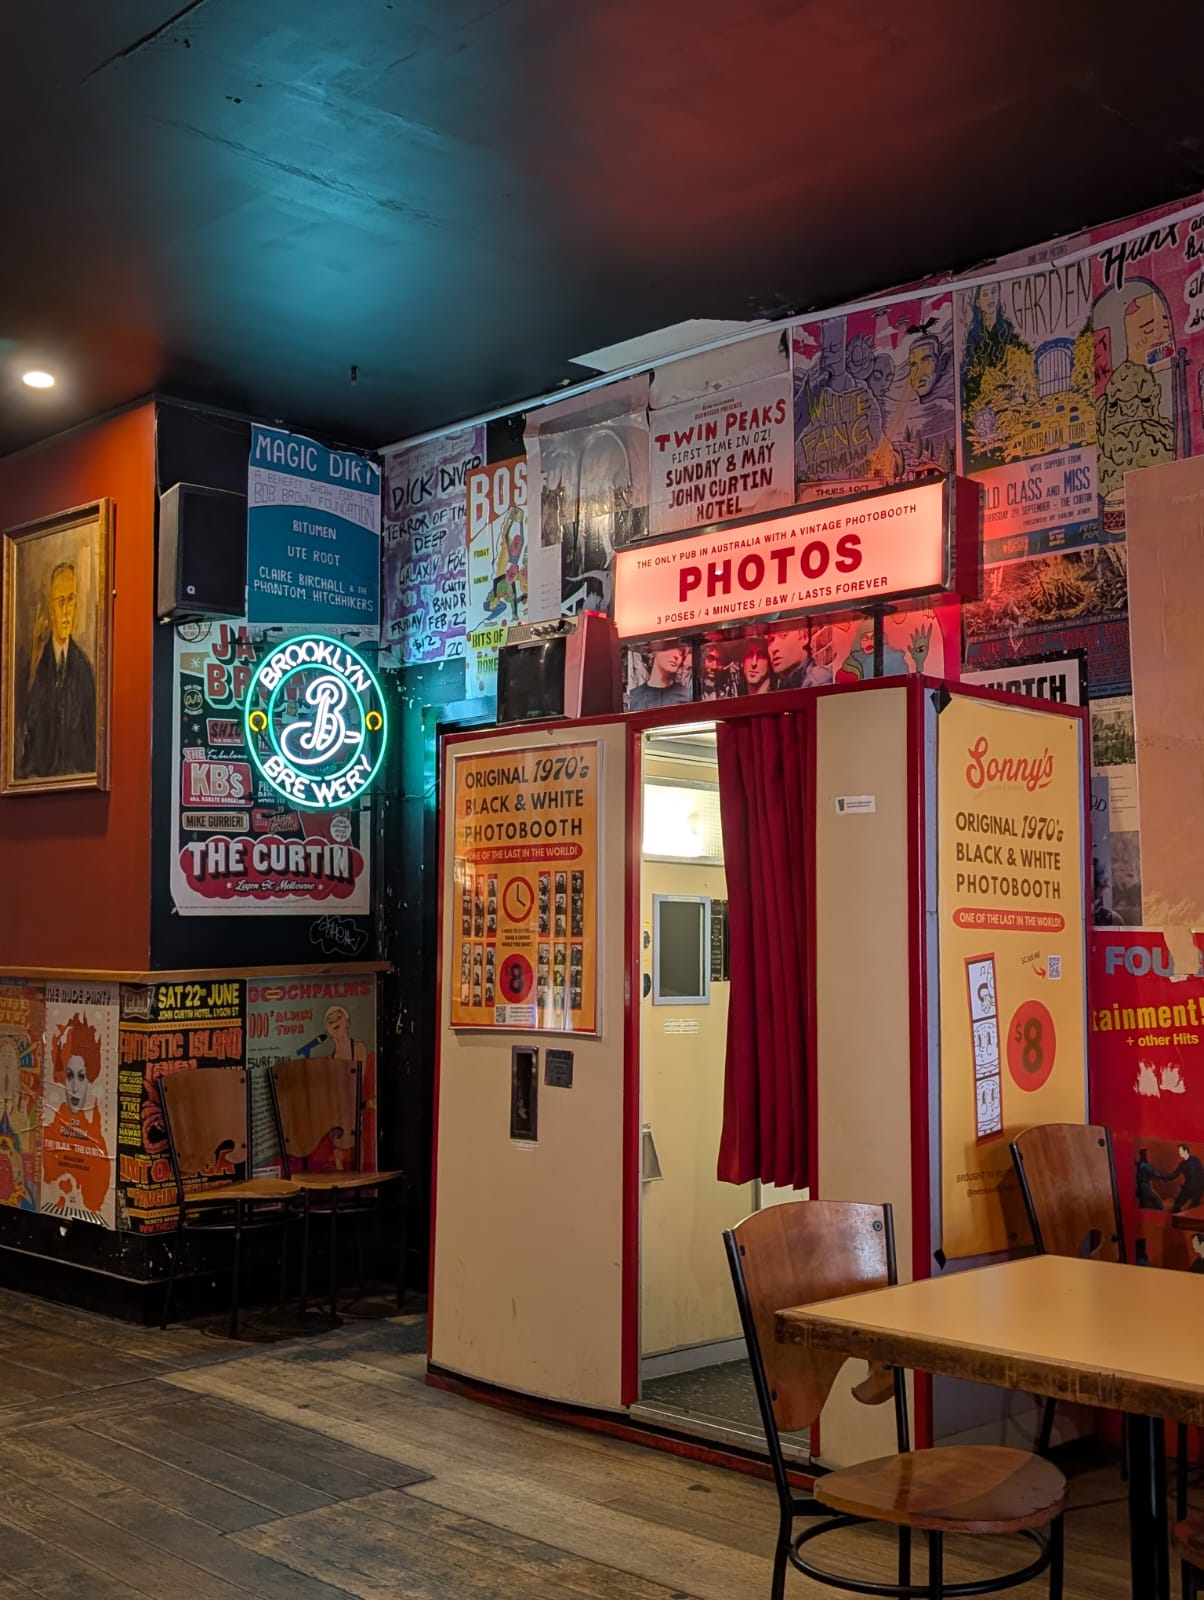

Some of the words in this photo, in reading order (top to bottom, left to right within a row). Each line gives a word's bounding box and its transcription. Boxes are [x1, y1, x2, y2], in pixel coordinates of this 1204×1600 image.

[1100, 224, 1178, 290] Hunx
[1012, 257, 1092, 335] GARDEN
[809, 390, 869, 425] WHITE
[655, 420, 719, 453] TWIN
[725, 398, 787, 441] PEAKS
[801, 415, 873, 460] FANG
[1022, 428, 1064, 451] AUSTRALIAN
[1068, 423, 1086, 442] TOUR
[255, 434, 318, 473] MAGIC
[330, 455, 375, 486] DIRT
[672, 446, 703, 465] FIRST
[705, 439, 733, 457] TIME
[736, 434, 750, 448] IN
[753, 429, 772, 445] OZ!
[806, 446, 868, 477] AUSTRALIAN
[665, 458, 720, 488] SUNDAY
[725, 456, 736, 472] 8
[741, 442, 776, 470] MAY
[1030, 462, 1043, 473] WITH
[1043, 457, 1066, 471] SUPPORT
[1068, 454, 1082, 466] FROM
[392, 474, 433, 511] DICK
[668, 485, 706, 509] JOHN
[709, 467, 773, 500] CURTIN
[816, 486, 845, 497] THURS
[853, 485, 869, 493] OCT
[1006, 476, 1042, 507] CLASS
[1046, 484, 1060, 497] AND
[1064, 466, 1091, 495] MISS
[319, 497, 376, 530] FOUNDATION
[696, 497, 743, 523] HOTEL
[1021, 501, 1051, 516] SEPTEMBER
[1061, 497, 1072, 508] THE
[1073, 492, 1092, 506] CURTIN
[292, 520, 337, 540] BITUMEN
[386, 515, 430, 542] TERROR
[433, 508, 448, 526] OF
[637, 558, 653, 570] THE
[655, 552, 678, 567] ONLY
[679, 549, 698, 562] PUB
[699, 546, 709, 557] IN
[711, 536, 762, 556] AUSTRALIA
[763, 530, 788, 544] WITH
[789, 528, 798, 538] A
[799, 519, 843, 537] VINTAGE
[845, 503, 917, 527] PHOTOBOOTH
[287, 545, 308, 561] UTE
[313, 551, 341, 567] ROOT
[414, 530, 447, 553] DEEP
[259, 566, 293, 583] CLAIRE
[299, 575, 345, 594] BIRCHALL
[679, 533, 863, 603] PHOTOS
[254, 580, 307, 600] PHANTOM
[313, 591, 374, 612] HITCHHIKERS
[656, 616, 663, 626] 3
[664, 608, 696, 625] POSES
[697, 608, 702, 619] /
[704, 607, 710, 618] 4
[712, 599, 756, 617] MINUTES
[757, 598, 763, 609] /
[765, 593, 790, 608] B&W
[790, 591, 796, 602] /
[798, 586, 833, 602] LASTS
[835, 576, 889, 595] FOREVER
[391, 610, 424, 636] FRIDAY
[429, 613, 447, 631] FEB
[412, 635, 436, 652] $12
[472, 631, 492, 649] BITS
[494, 628, 504, 643] OF
[258, 640, 373, 692] BROOKLYN
[184, 749, 205, 760] THE
[966, 736, 1054, 792] Sonny's
[191, 763, 244, 797] KB's
[263, 753, 372, 803] BREWERY
[465, 766, 528, 790] ORIGINAL
[532, 756, 589, 783] 1970's
[465, 795, 510, 816] BLACK
[514, 794, 527, 811] &
[531, 788, 584, 810] WHITE
[186, 815, 206, 828] MIKE
[208, 815, 244, 828] GURRIERI
[465, 818, 583, 843] PHOTOBOOTH
[955, 811, 1018, 837] ORIGINAL
[1021, 815, 1064, 843] 1970's
[188, 842, 243, 878] THE
[252, 842, 352, 881] CURTIN
[481, 849, 490, 860] OF
[491, 848, 503, 859] THE
[504, 847, 521, 859] LAST
[523, 847, 530, 858] IN
[531, 847, 545, 857] THE
[546, 845, 578, 857] WORLD!
[956, 842, 1003, 865] BLACK
[1006, 847, 1017, 867] &
[1020, 848, 1061, 871] WHITE
[276, 880, 316, 891] Melbourne
[956, 873, 1061, 900] PHOTOBOOTH
[959, 912, 975, 923] ONE
[976, 912, 986, 924] OF
[987, 913, 1000, 924] THE
[1000, 914, 1016, 925] LAST
[1017, 915, 1024, 925] IN
[1024, 915, 1037, 926] THE
[1037, 915, 1061, 928] WORLD!
[1020, 954, 1034, 965] SCAN
[504, 962, 524, 995] $8
[158, 985, 184, 1009] SAT
[207, 983, 240, 1006] JUNE
[158, 1010, 174, 1020] JOHN
[174, 1009, 193, 1020] CURTIN
[213, 1007, 231, 1018] LYGON
[232, 1006, 239, 1017] ST
[188, 1028, 243, 1061] ISLAND
[276, 1024, 305, 1036] TOUR
[1138, 1034, 1171, 1046] other
[1173, 1032, 1200, 1046] Hits
[1015, 1017, 1043, 1074] $8
[248, 1055, 272, 1070] SURF
[121, 1101, 140, 1112] TIKI
